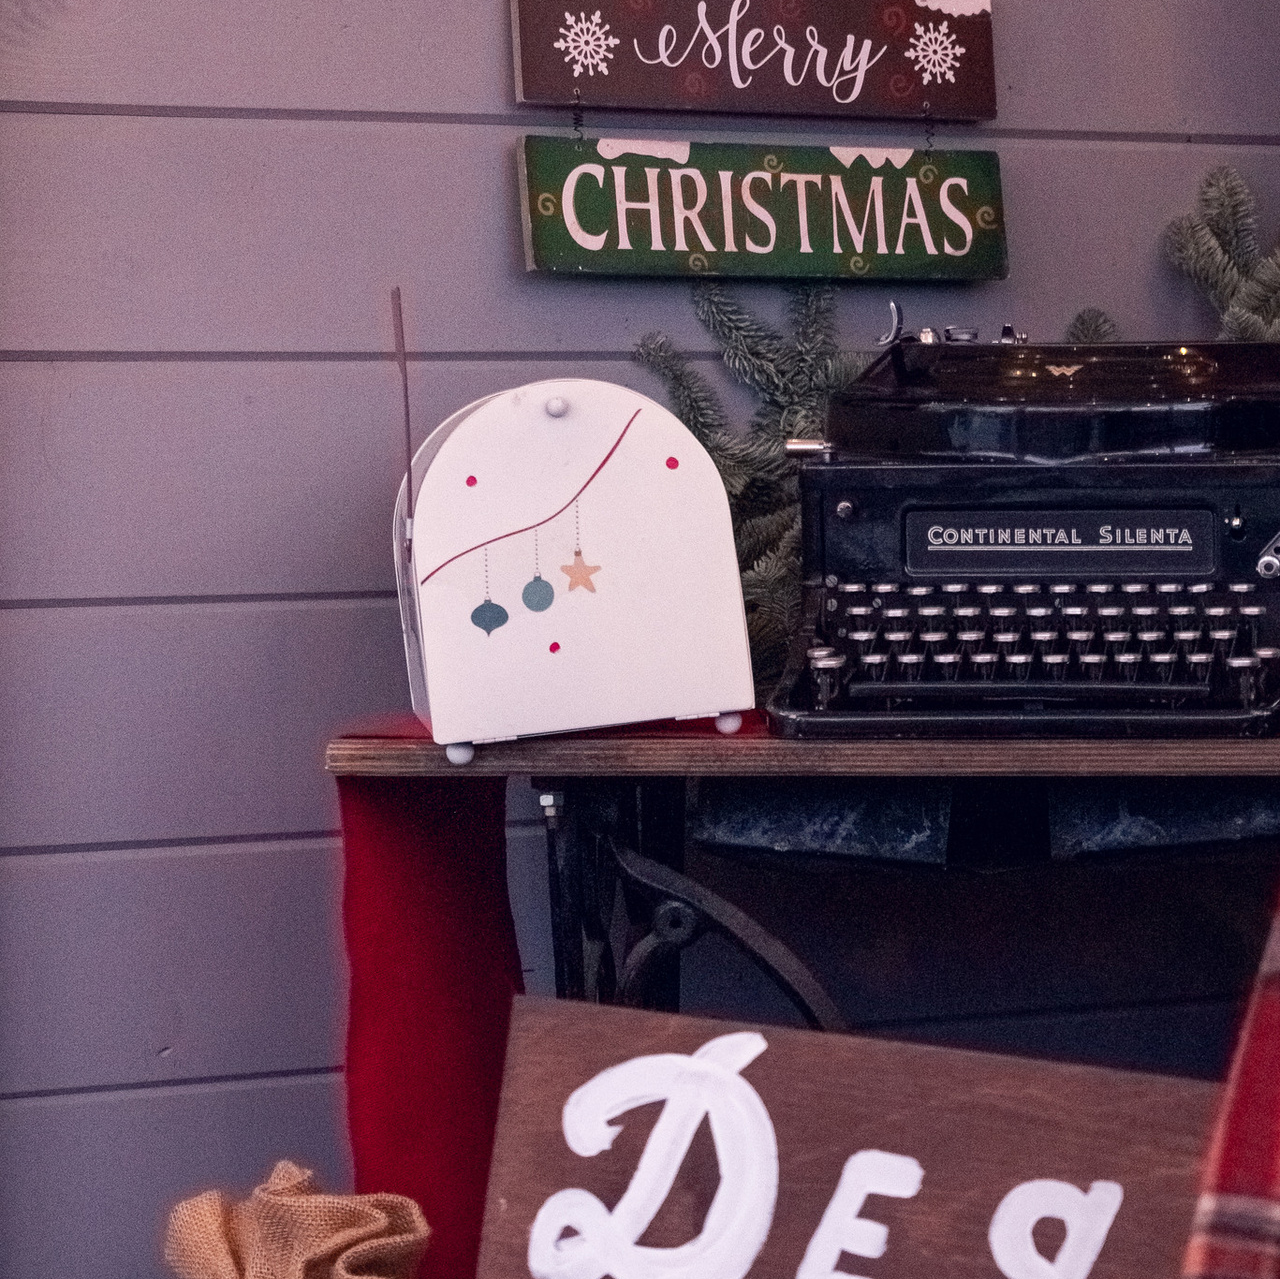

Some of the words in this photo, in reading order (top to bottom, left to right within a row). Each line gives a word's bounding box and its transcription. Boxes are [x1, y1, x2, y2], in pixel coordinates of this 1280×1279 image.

[560, 162, 974, 257] CHRISTMAS
[927, 525, 1082, 545] CONTINENTAL
[1099, 525, 1193, 545] SILENTA
